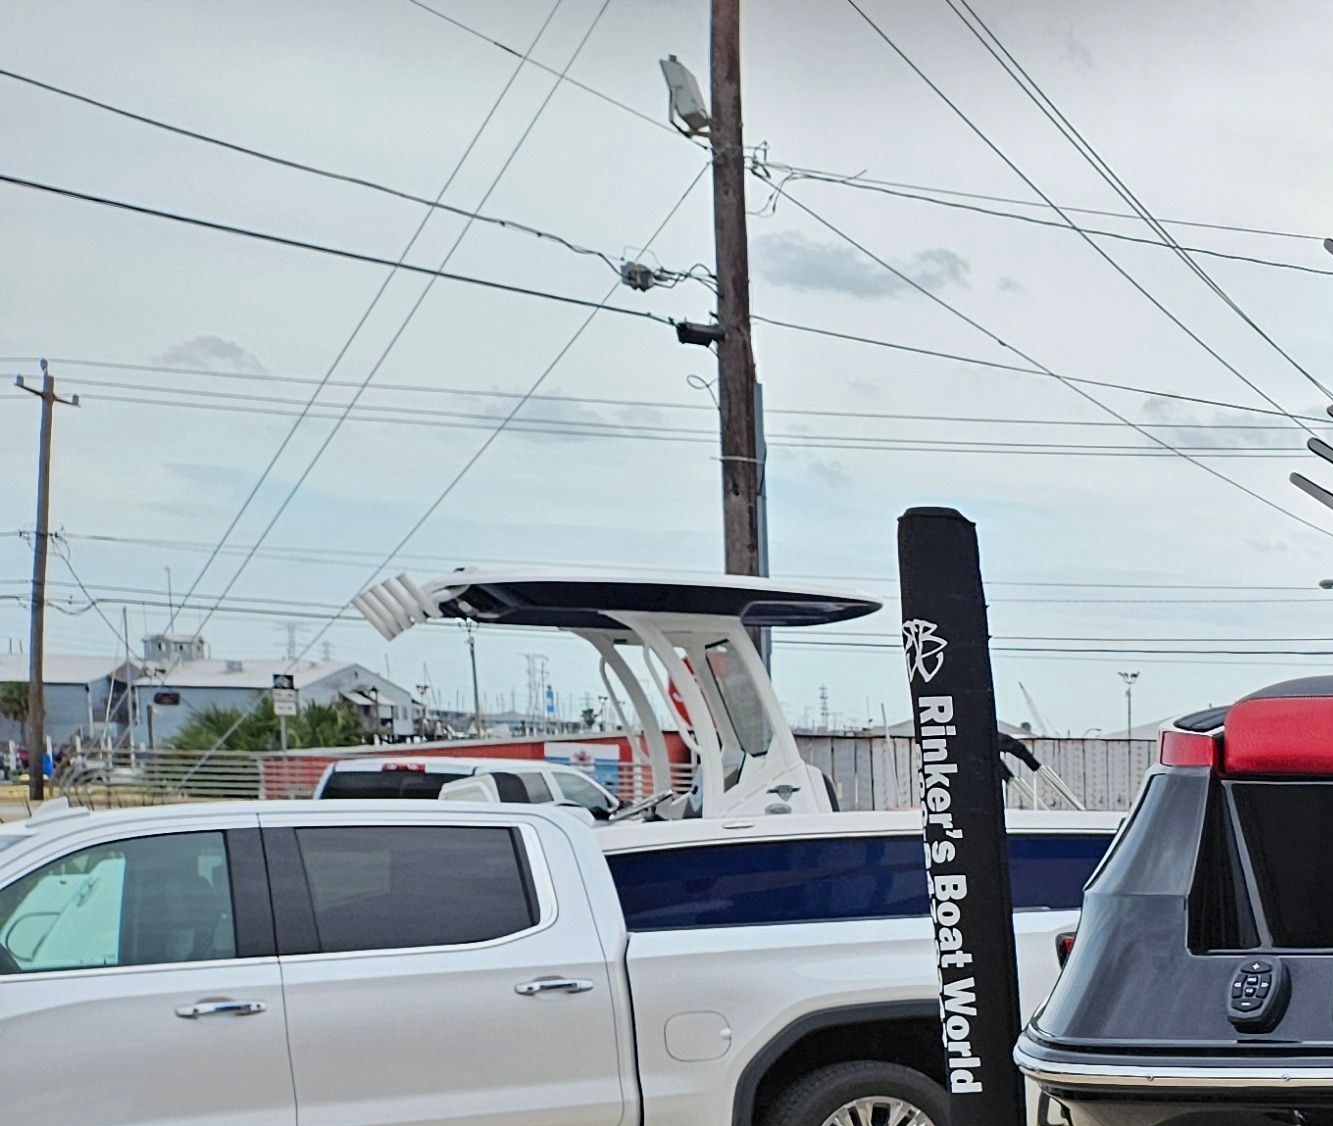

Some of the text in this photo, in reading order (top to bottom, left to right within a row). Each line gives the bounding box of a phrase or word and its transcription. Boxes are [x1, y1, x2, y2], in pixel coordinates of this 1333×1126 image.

[918, 695, 964, 864] Rinker's
[933, 874, 973, 968] Boat
[943, 977, 983, 1094] World
